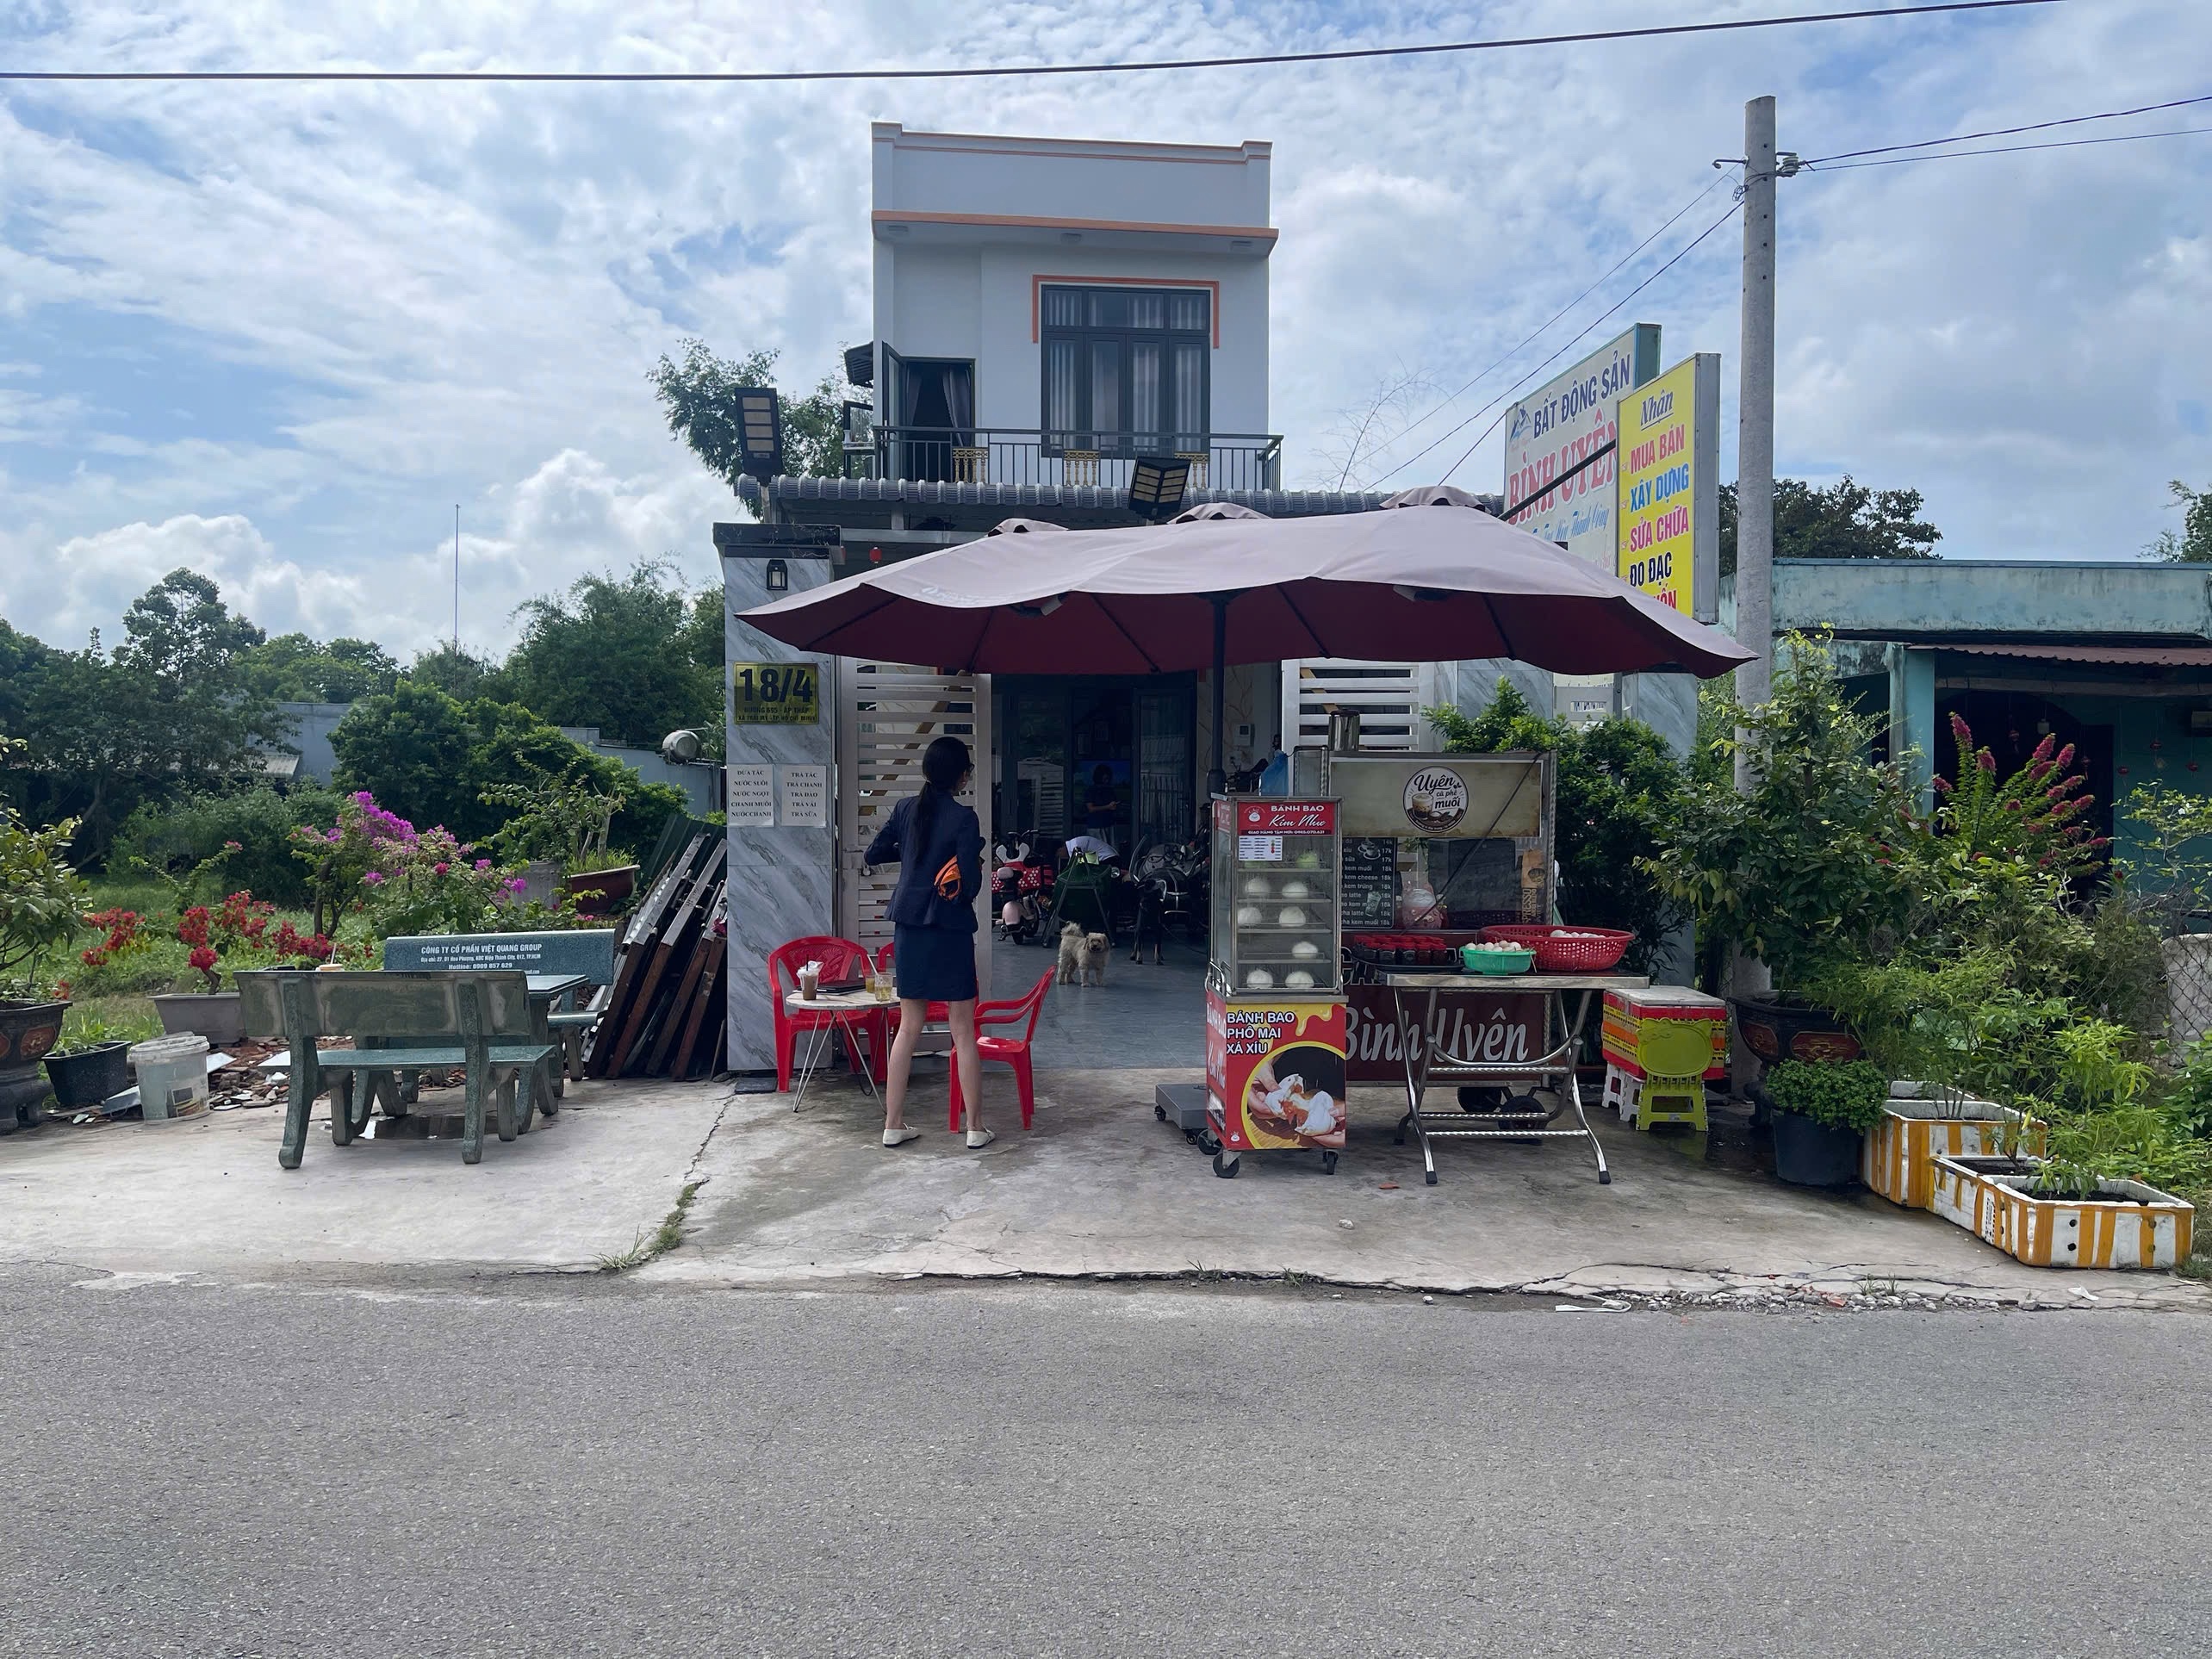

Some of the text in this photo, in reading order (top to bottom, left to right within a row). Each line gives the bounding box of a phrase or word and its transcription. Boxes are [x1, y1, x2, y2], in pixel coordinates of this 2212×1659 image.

[1534, 350, 1630, 439] BẤT ĐỘNG SẢN
[1641, 389, 1673, 426] Nhận
[1631, 424, 1684, 475] MUA BÁN
[1508, 450, 1556, 525] BÌNH
[1631, 463, 1689, 513] XÂY DỰNG
[1631, 506, 1689, 552] SỬA CHỮA
[1630, 564, 1644, 587] ĐO
[1649, 552, 1672, 586] ĐẠC
[740, 668, 813, 703] 18/4
[1414, 774, 1456, 794] Uyên
[1445, 789, 1457, 798] phê
[1435, 796, 1461, 809] muối
[1269, 814, 1296, 827] Kim
[421, 946, 440, 954] CÔNG
[482, 943, 494, 954] VIỆT
[496, 944, 518, 953] QUANG
[1227, 1010, 1295, 1023] BÁNH BAO
[1227, 1026, 1281, 1039] PHÔ MAI
[1345, 1006, 1423, 1061] Bình
[1227, 1041, 1268, 1054] XÁ XÍU
